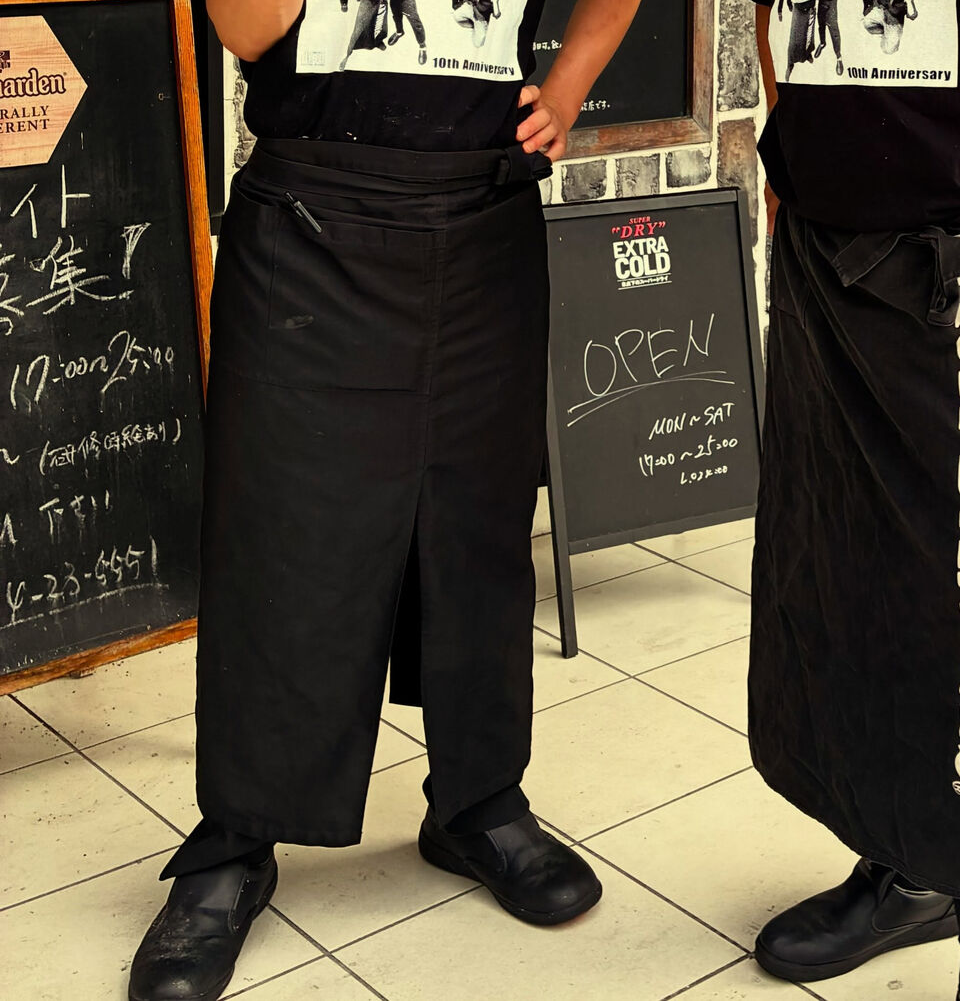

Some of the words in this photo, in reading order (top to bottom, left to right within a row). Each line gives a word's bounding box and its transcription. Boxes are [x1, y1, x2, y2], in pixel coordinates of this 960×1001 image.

[432, 57, 460, 71] 10th
[462, 58, 515, 76] Anniversary
[847, 67, 868, 80] 10th
[871, 67, 951, 82] Anniversary
[0, 67, 67, 99] arden
[628, 215, 651, 225] SUPER
[612, 235, 669, 259] EXTRA
[615, 252, 671, 280] COLD
[584, 313, 715, 398] OPEN
